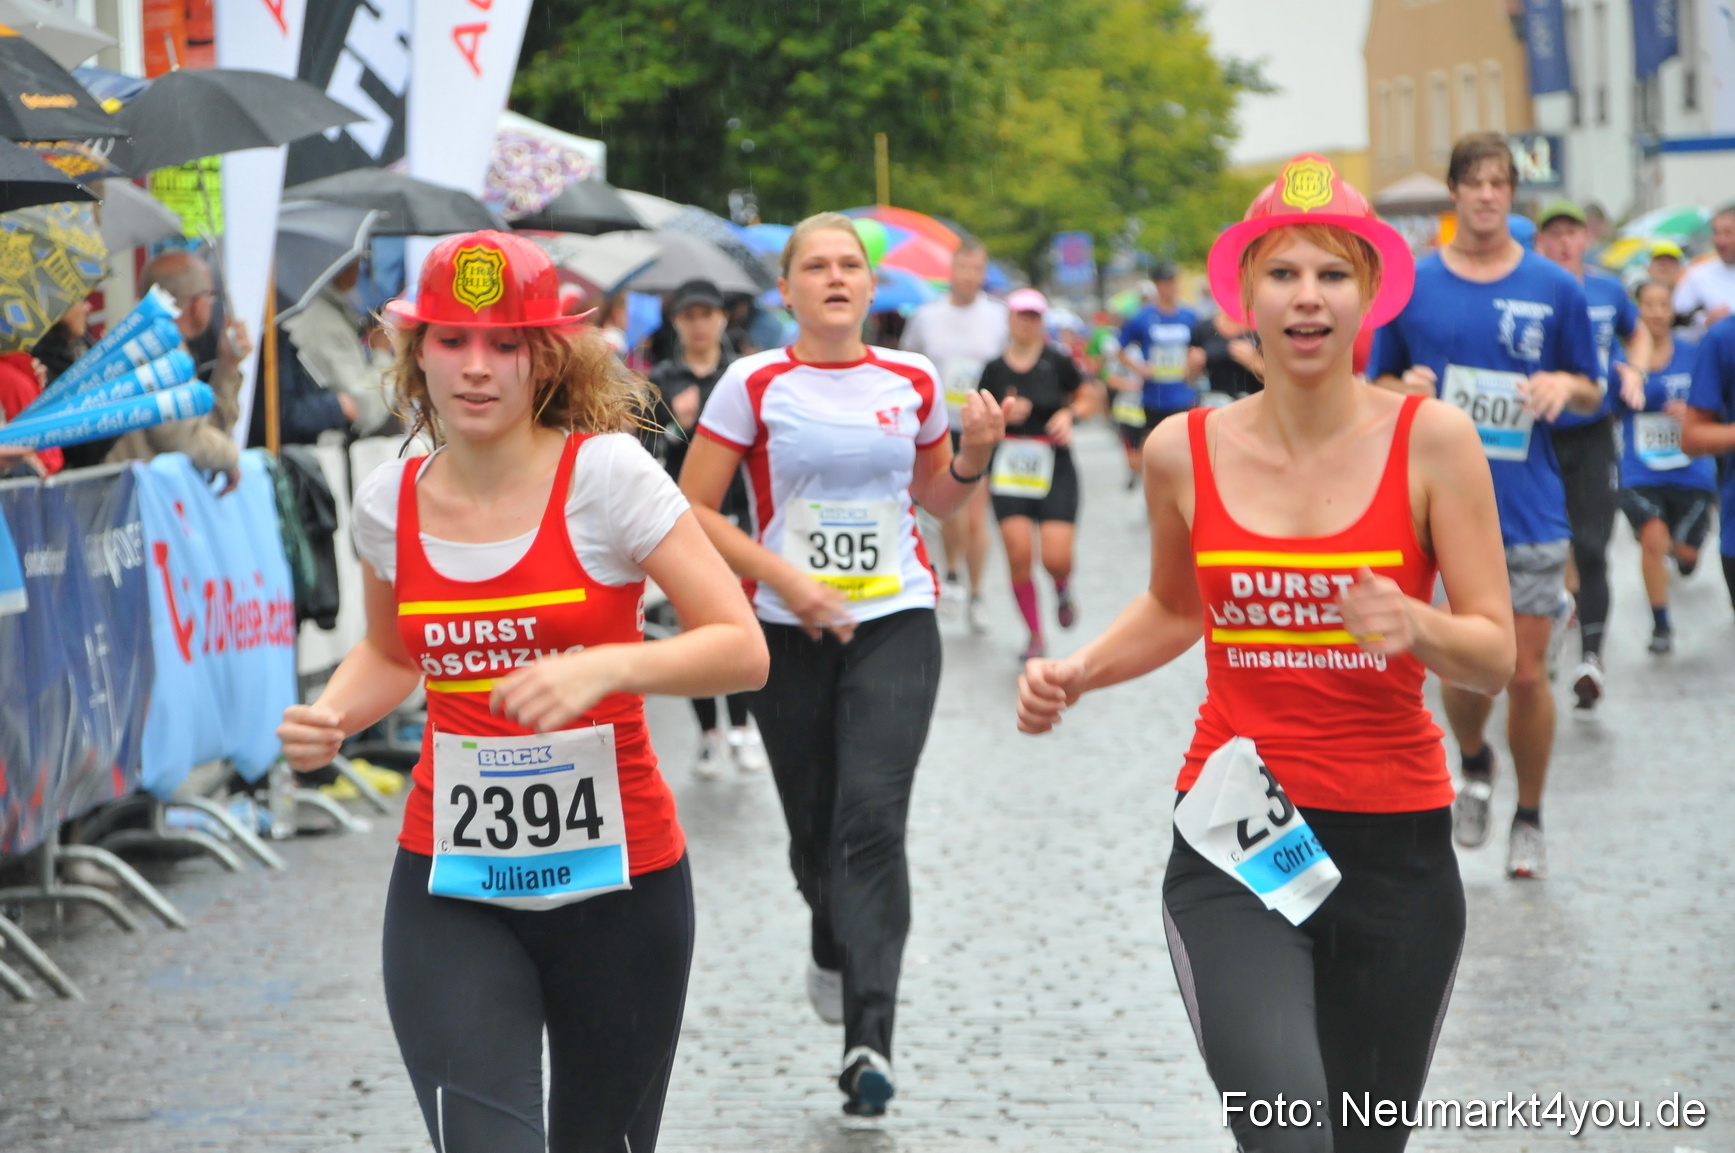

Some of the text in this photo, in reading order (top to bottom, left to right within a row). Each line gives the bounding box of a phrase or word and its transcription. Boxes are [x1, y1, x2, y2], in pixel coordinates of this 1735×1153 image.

[1454, 389, 1525, 428] 2607
[809, 531, 879, 571] 395
[1230, 571, 1354, 600] DURST
[1208, 600, 1345, 627] LÖSCHZ
[424, 616, 537, 647] DURST
[1227, 647, 1388, 673] Einsatzleitung
[478, 745, 552, 767] BOCK
[450, 776, 604, 850] 2394
[481, 864, 572, 891] Juliane
